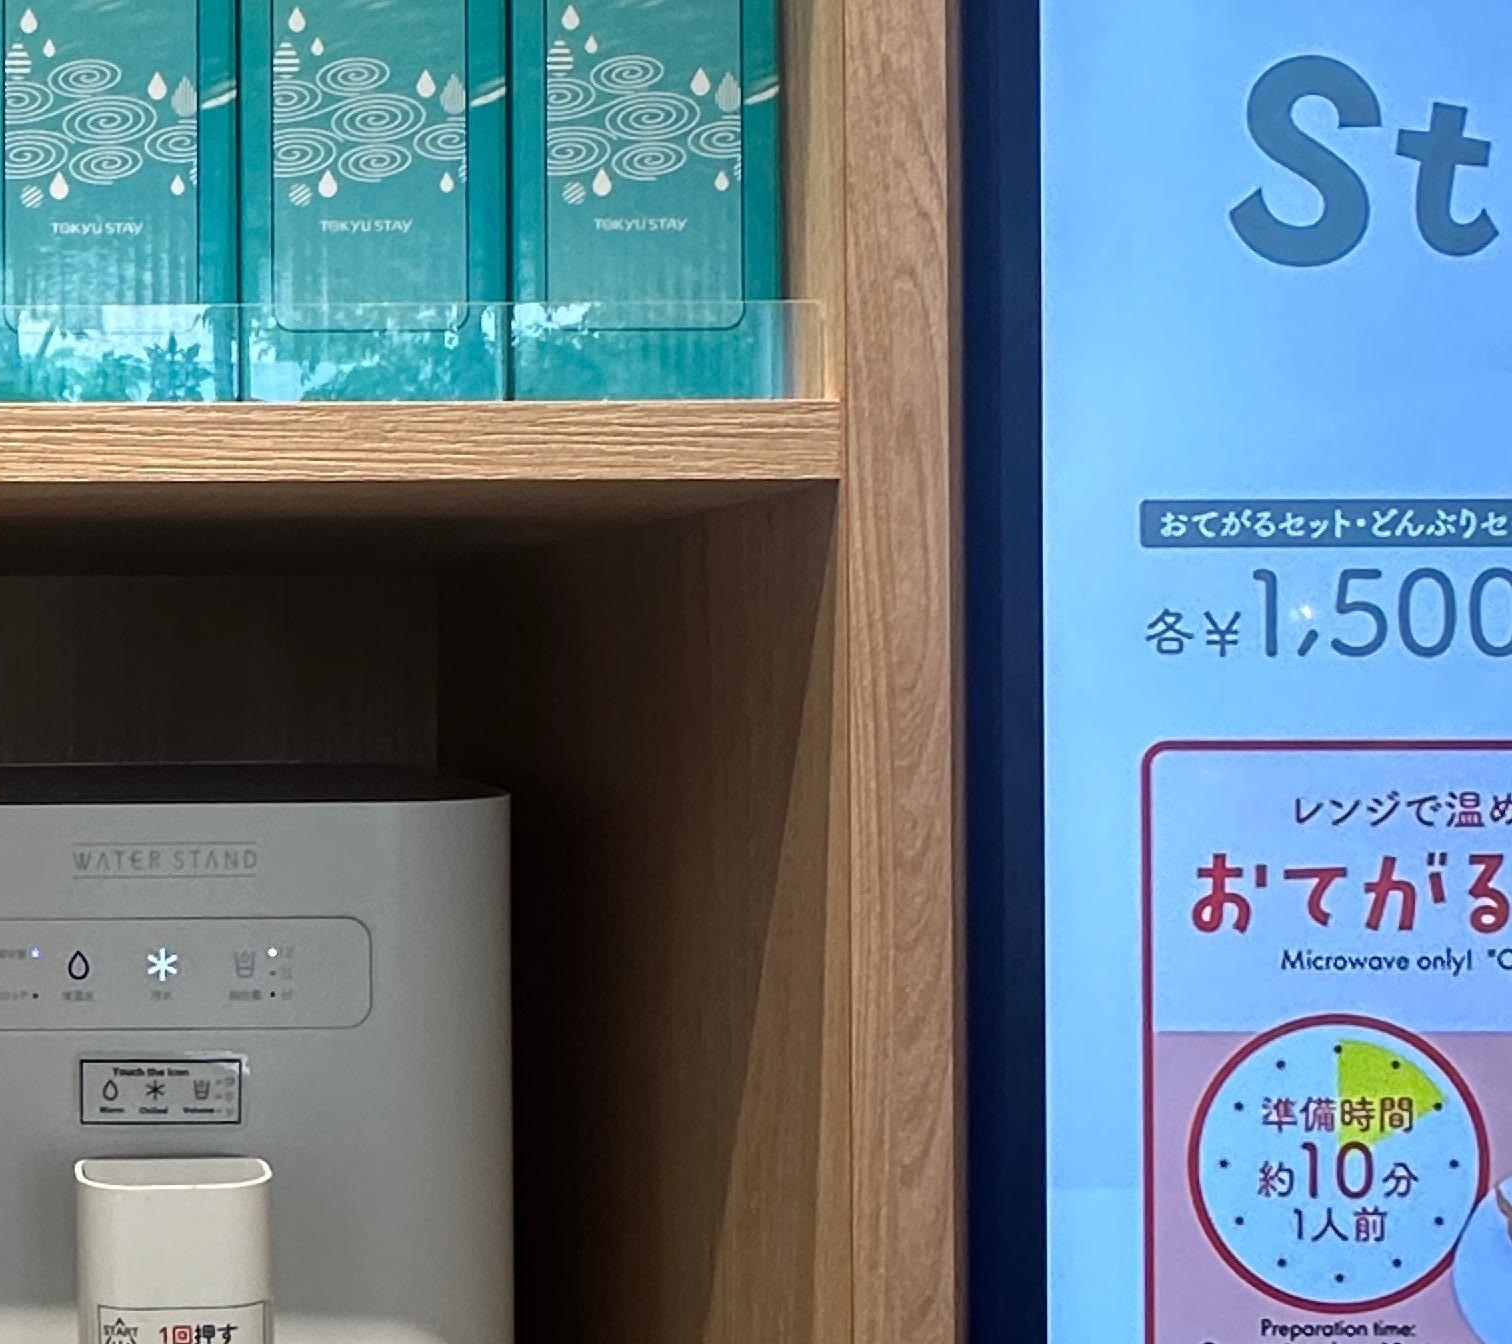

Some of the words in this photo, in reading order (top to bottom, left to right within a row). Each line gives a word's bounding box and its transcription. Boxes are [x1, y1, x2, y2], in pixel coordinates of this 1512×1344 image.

[50, 221, 102, 235] TOKYU
[104, 221, 144, 236] STAY
[320, 219, 372, 233] TOKYU
[374, 219, 412, 234] STAY
[594, 217, 646, 231] TOKYU
[648, 217, 688, 232] STAY
[1160, 508, 1509, 540] おてがるセット・どんぶりセ
[72, 849, 163, 873] WATER
[173, 848, 259, 871] STAND
[1191, 852, 1512, 934] おてがる
[1280, 949, 1410, 971] Microwave
[1416, 946, 1472, 977] only!
[1260, 1096, 1415, 1134] 準備時間
[1257, 1140, 1419, 1201] 約10分
[1293, 1207, 1388, 1243] 1人前
[1260, 1318, 1369, 1342] Preparation
[1373, 1320, 1417, 1338] time:
